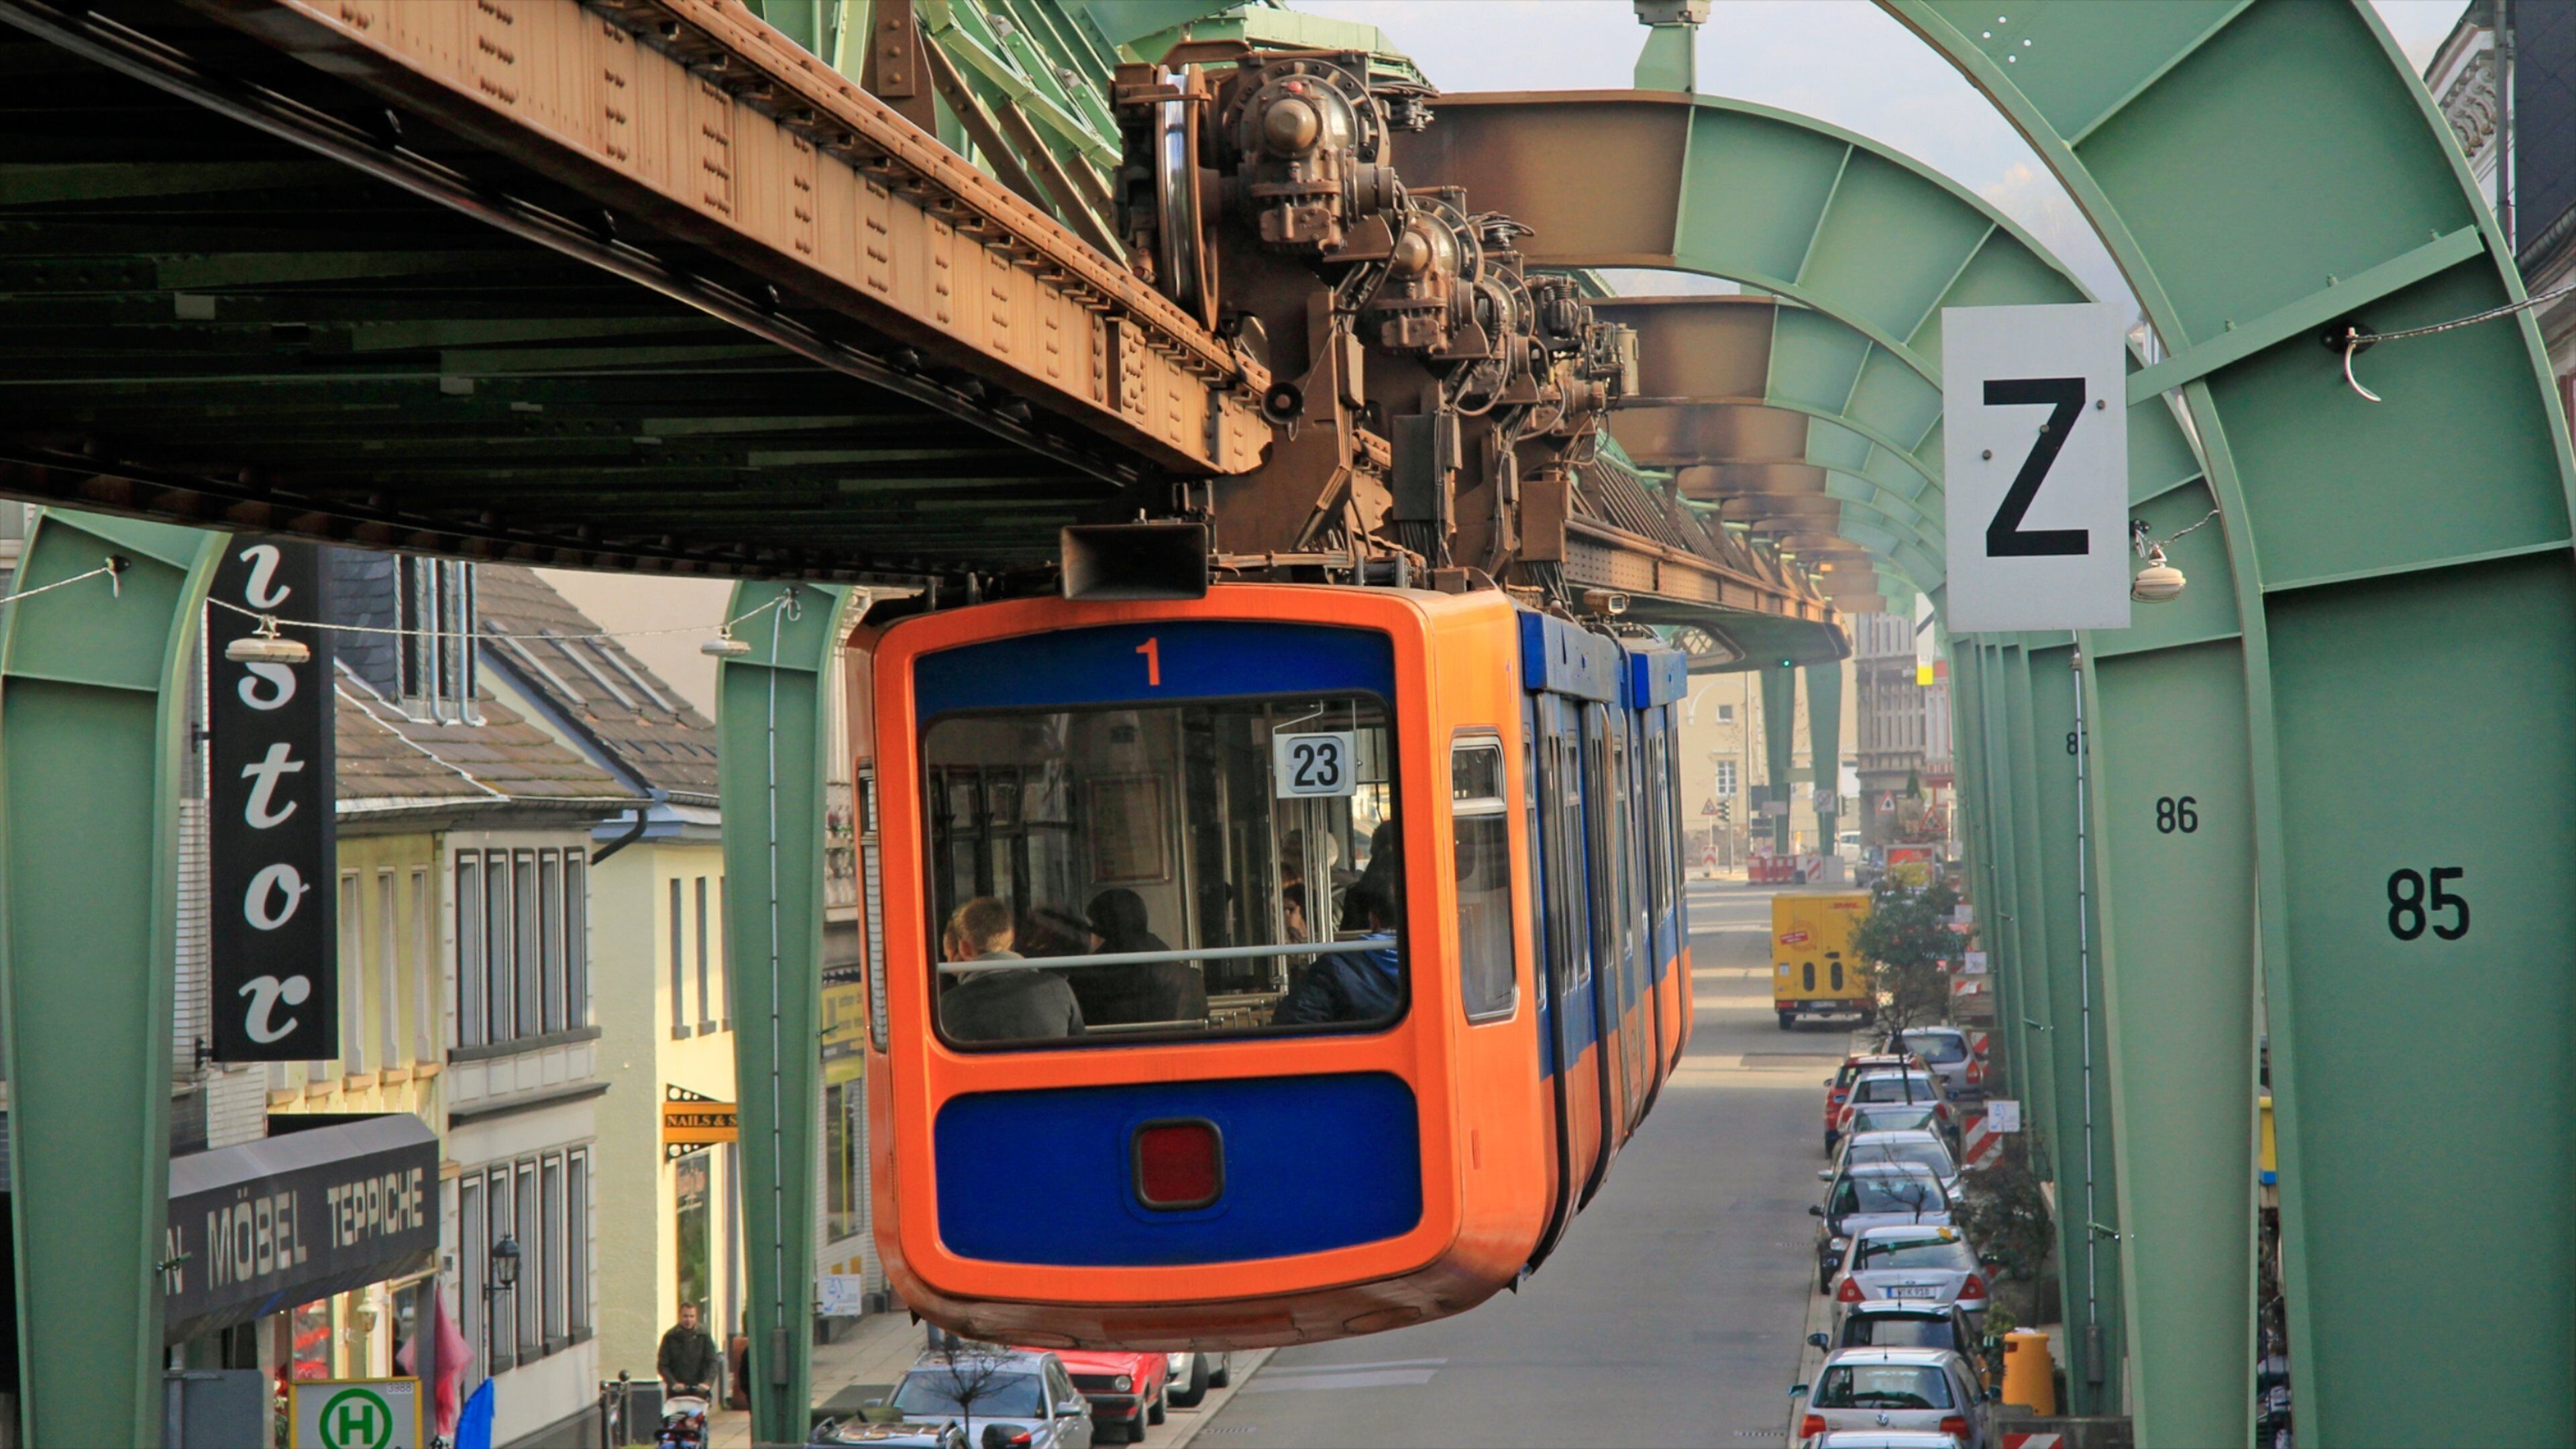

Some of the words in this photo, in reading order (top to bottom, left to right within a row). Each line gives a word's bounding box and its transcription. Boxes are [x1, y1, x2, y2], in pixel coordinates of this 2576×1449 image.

[1984, 377, 2089, 557] Z
[1136, 637, 1160, 686] 1
[1293, 743, 1339, 786] 23
[2156, 796, 2198, 834] 86
[2387, 867, 2470, 941] 85
[667, 1114, 711, 1126] NAILS
[713, 1114, 724, 1126] &
[207, 1188, 308, 1291] MÖBEL
[327, 1167, 424, 1249] TEPPICHE
[388, 1383, 412, 1393] 3988
[339, 1405, 373, 1445] H
